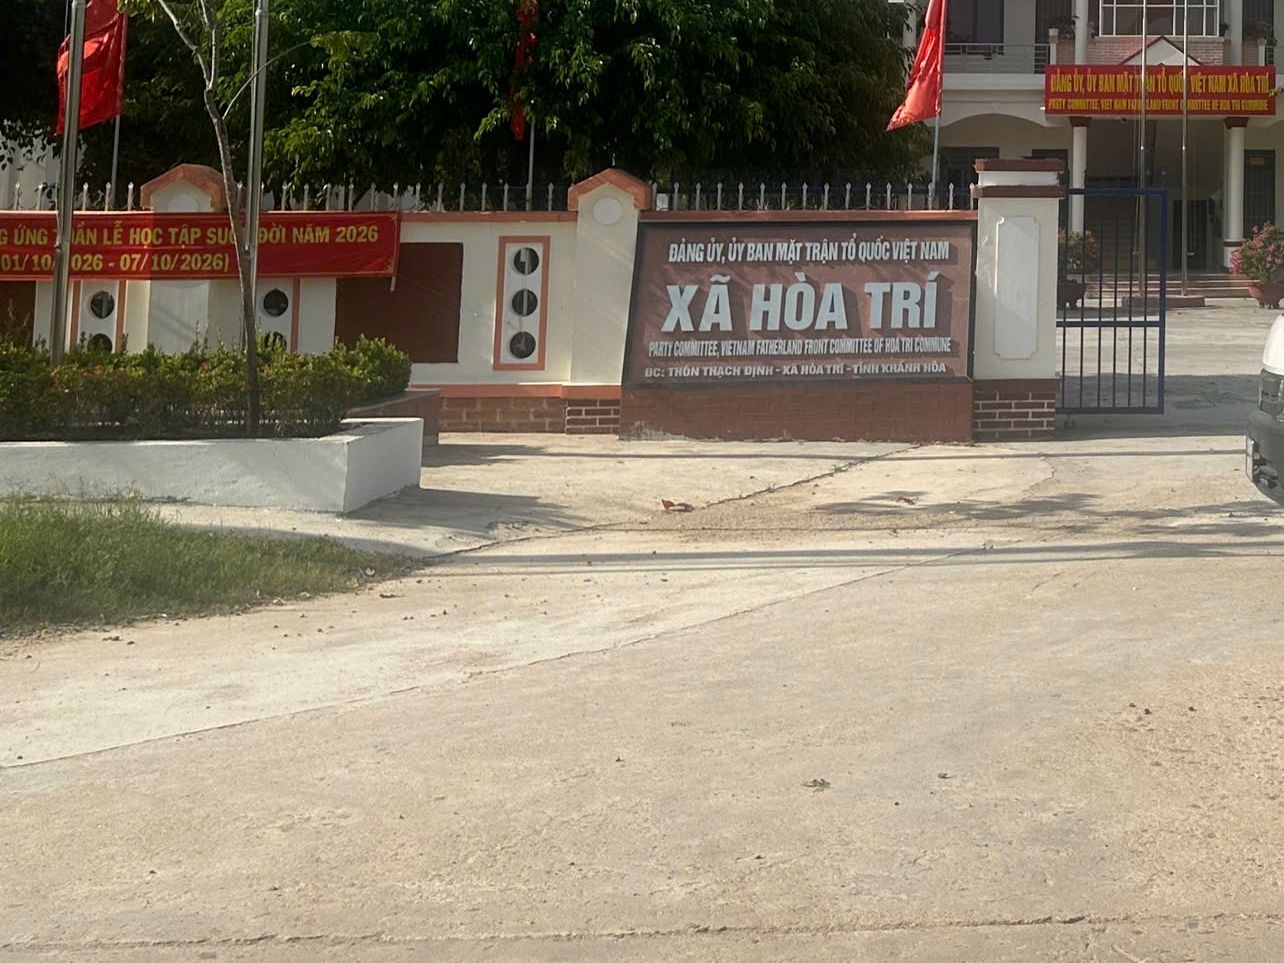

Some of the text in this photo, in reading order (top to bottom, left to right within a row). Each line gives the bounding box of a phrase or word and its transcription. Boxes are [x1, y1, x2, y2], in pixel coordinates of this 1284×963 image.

[14, 224, 48, 245] ỨNG
[103, 220, 122, 245] LỄ
[129, 227, 163, 248] HỌC
[168, 224, 201, 248] TẬP
[257, 222, 286, 244] ĐỜI
[293, 224, 329, 243] NĂM
[335, 225, 379, 243] 2026
[668, 232, 950, 265] ĐẢNG ỦY, ỦY BAN MẶT TRẬN TỔ QUỐC VIỆT NAM
[120, 253, 229, 272] 07/10/2026)
[661, 271, 940, 332] XÃ HÒA TRÍ
[649, 341, 673, 357] PARTY
[673, 340, 719, 357] COMMITTEE,
[721, 340, 755, 356] VIETNAM
[756, 339, 803, 355] FATHERLAND
[804, 338, 829, 354] FRONT
[830, 338, 872, 354] COMMITTEE
[874, 338, 883, 353] OF
[914, 337, 951, 353] COMMUNE
[703, 365, 740, 378] THẠCH
[744, 365, 773, 378] ĐỊNH
[782, 363, 798, 376] XÃ
[881, 360, 920, 373] KHÁNH
